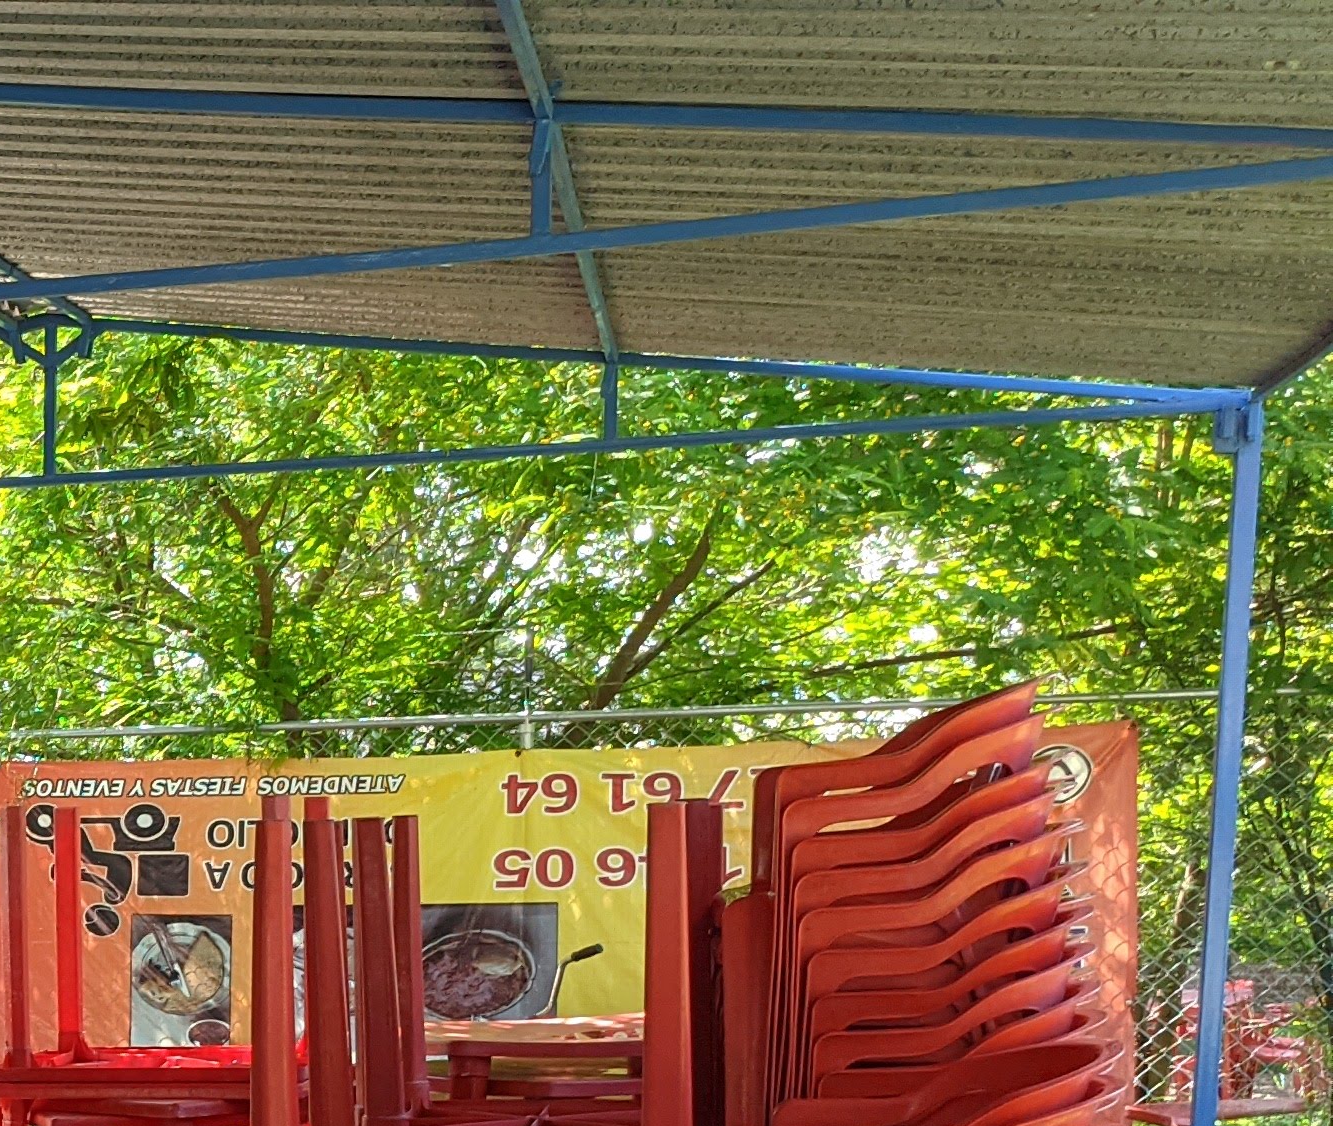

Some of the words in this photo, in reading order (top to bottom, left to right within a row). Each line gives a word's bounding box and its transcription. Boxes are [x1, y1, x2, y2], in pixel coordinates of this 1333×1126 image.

[22, 777, 125, 798] EVENTOS
[128, 778, 143, 797] Y
[150, 776, 246, 797] FIESTAS
[257, 774, 405, 797] ATENDEMOS
[501, 773, 577, 814] 64
[601, 772, 682, 813] 61
[203, 860, 231, 890] A
[493, 848, 575, 888] 05
